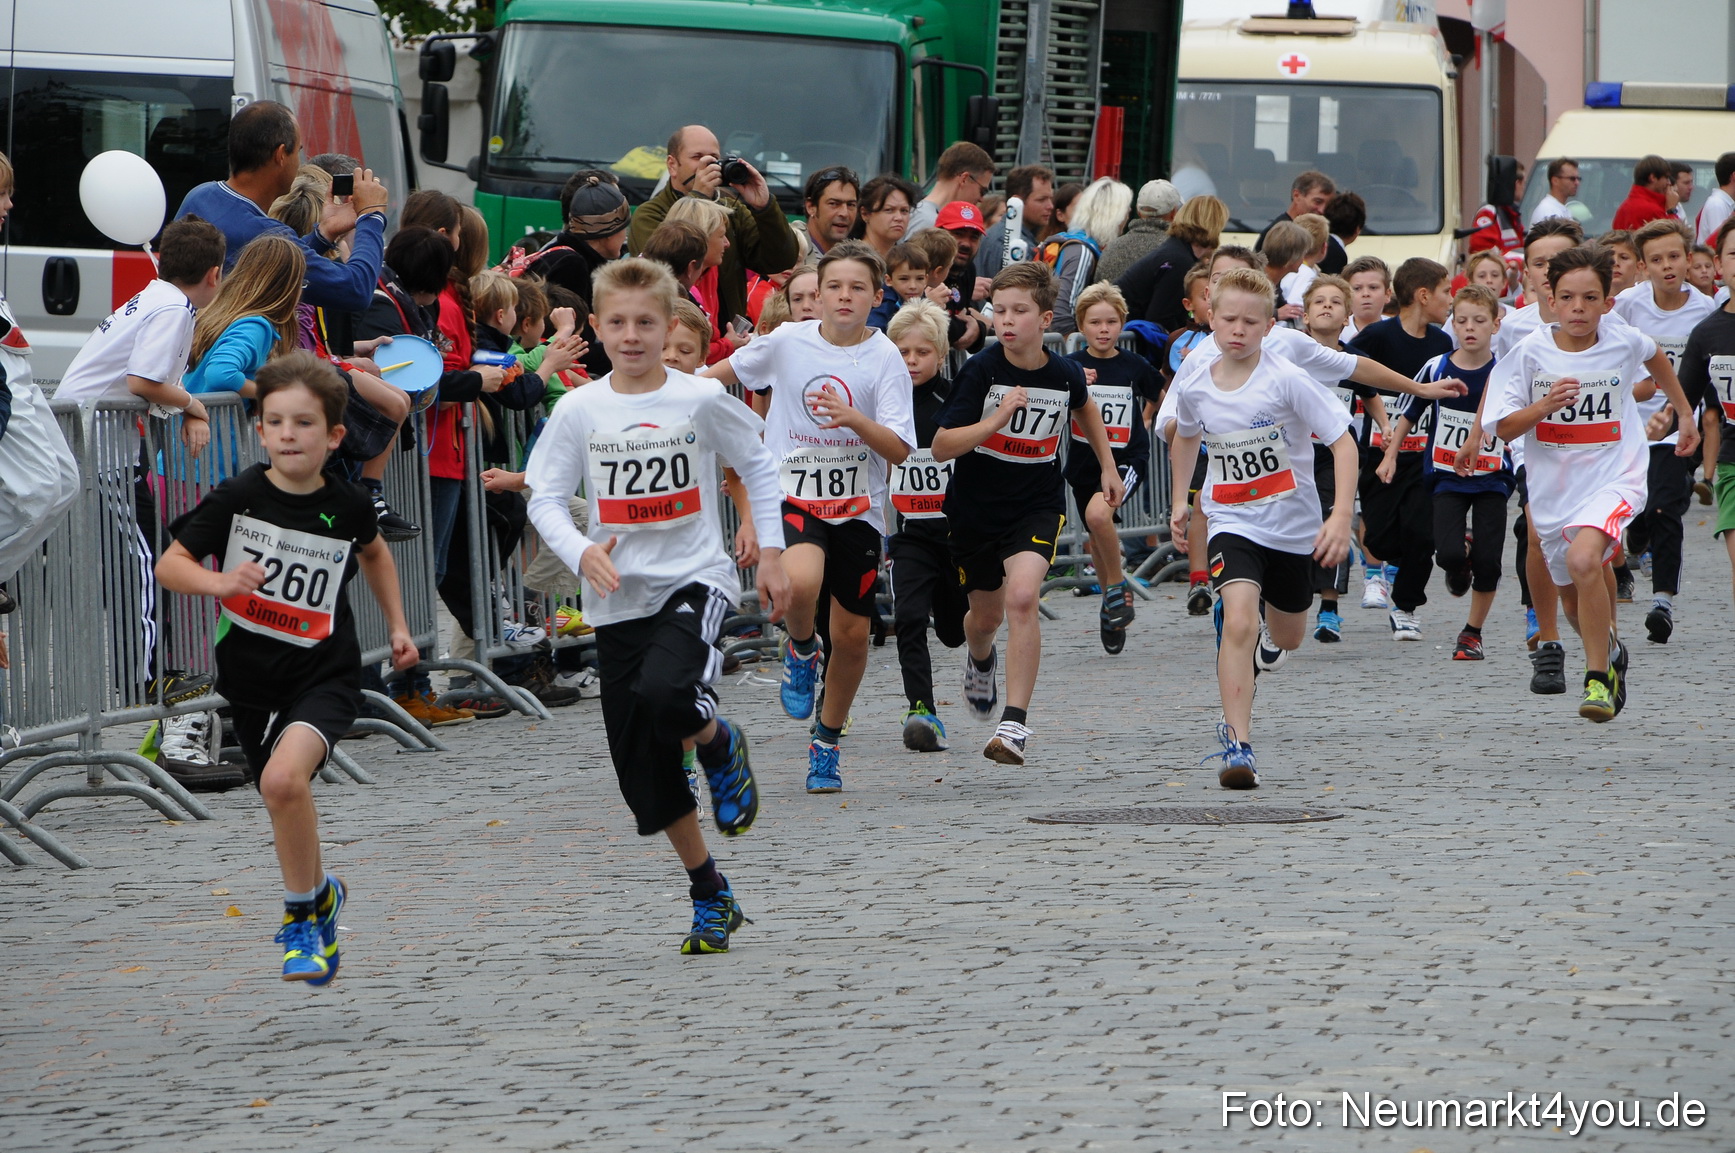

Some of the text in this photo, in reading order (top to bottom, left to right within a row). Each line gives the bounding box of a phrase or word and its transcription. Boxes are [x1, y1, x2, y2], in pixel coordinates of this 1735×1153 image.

[1092, 391, 1125, 399] Neumarkt
[1010, 406, 1061, 435] 071
[590, 437, 681, 453] PARTL Neumarkt
[824, 438, 841, 446] MIT
[1004, 440, 1039, 455] Kilian
[1225, 436, 1266, 449] Neumarkt
[814, 454, 854, 463] Neumarkt
[1214, 446, 1279, 482] 7386
[600, 453, 690, 496] 7220
[791, 466, 858, 498] 7187
[627, 500, 673, 520] David
[808, 502, 849, 516] Patrick
[910, 498, 943, 510] Fabia
[234, 525, 331, 561] PARTL Neumarkt
[246, 600, 299, 631] Simon
